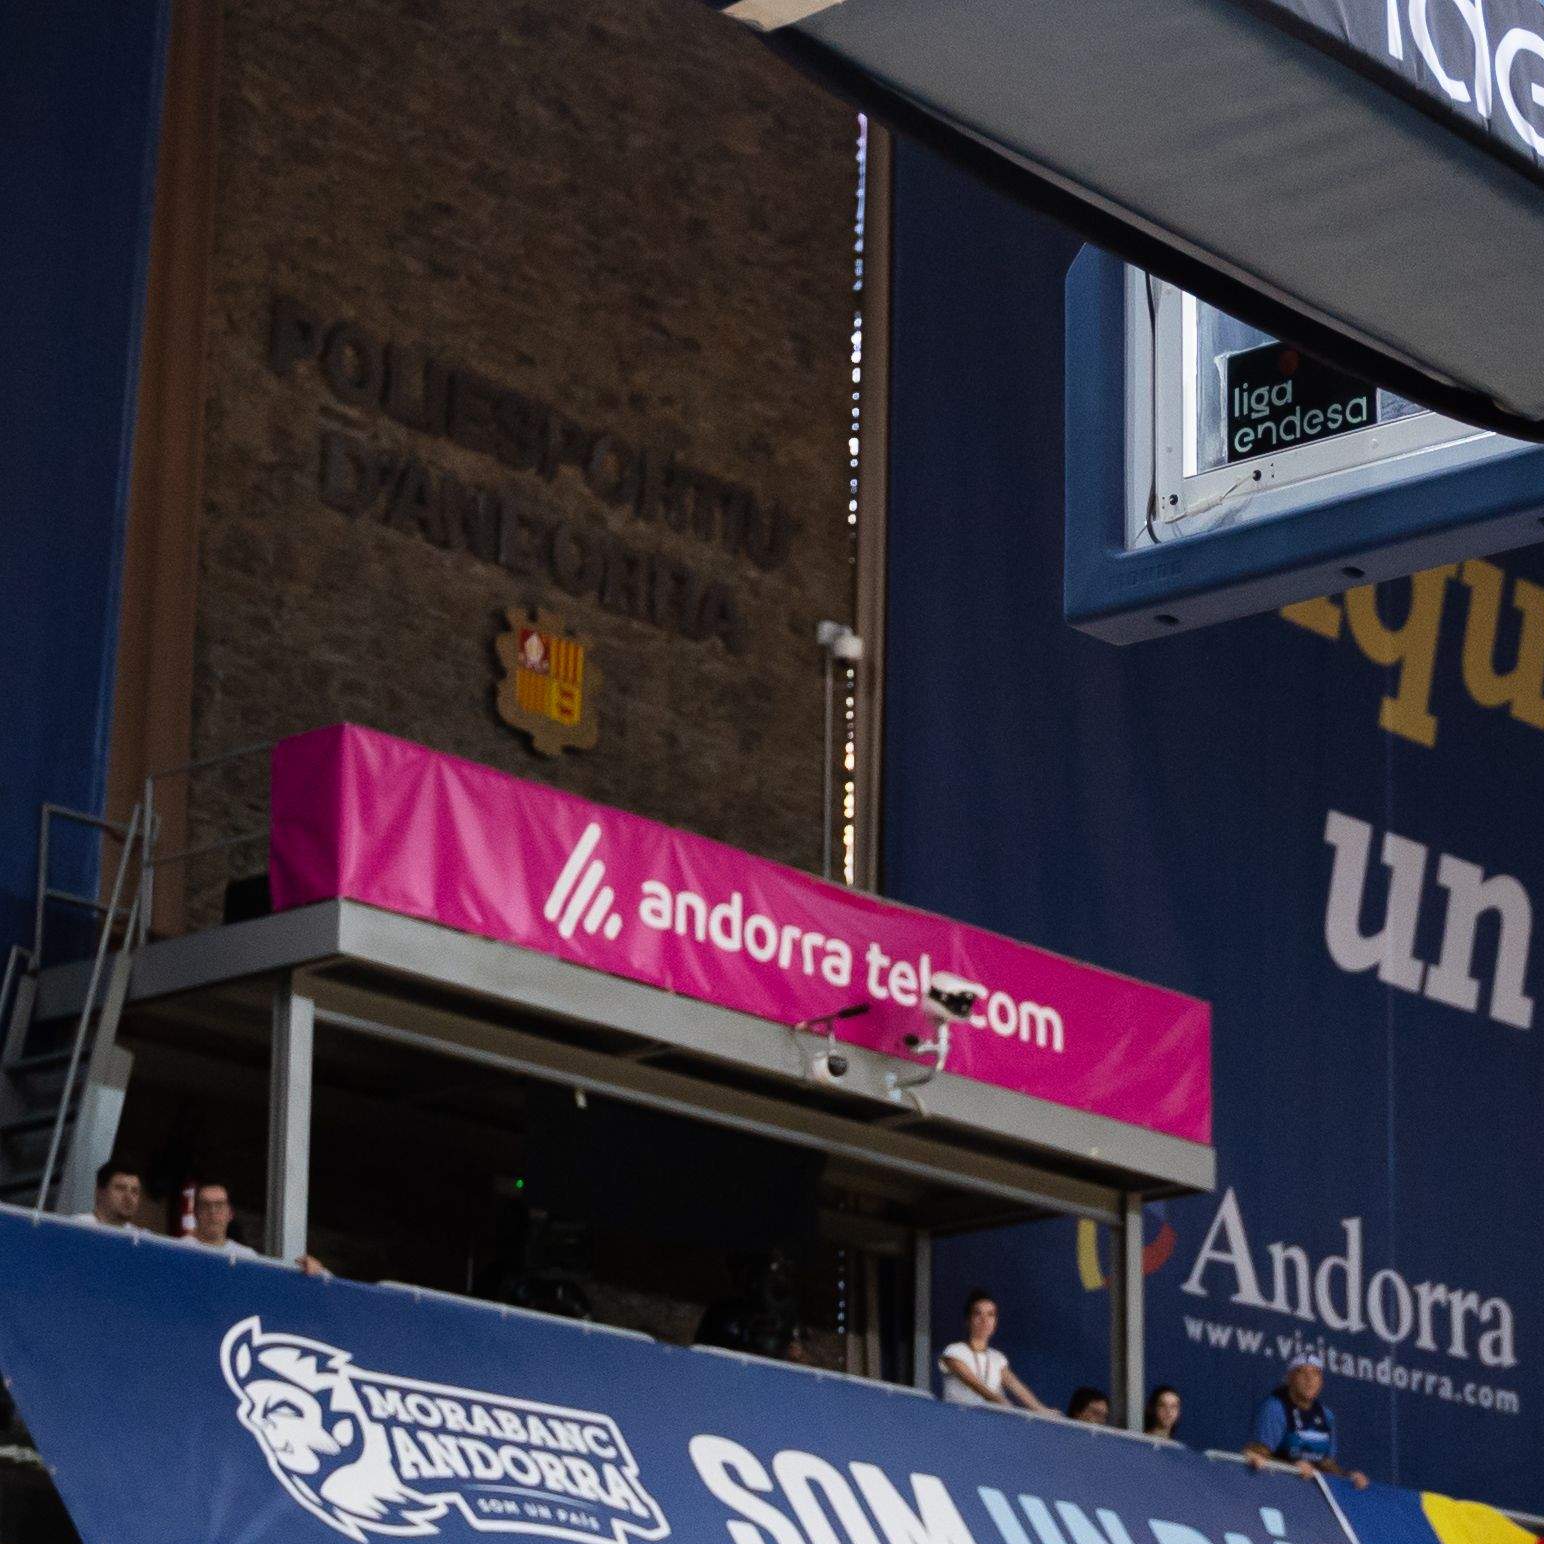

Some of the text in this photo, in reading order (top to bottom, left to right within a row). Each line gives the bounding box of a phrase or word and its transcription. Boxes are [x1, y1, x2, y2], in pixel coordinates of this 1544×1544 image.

[1234, 379, 1293, 420] liga
[1234, 395, 1367, 453] endesa
[638, 879, 1065, 1053] andorra telcom
[1323, 808, 1534, 1031] un
[1180, 1186, 1517, 1369] Andorra
[361, 1384, 618, 1459] MORABANC
[393, 1426, 651, 1519] ANDORRA
